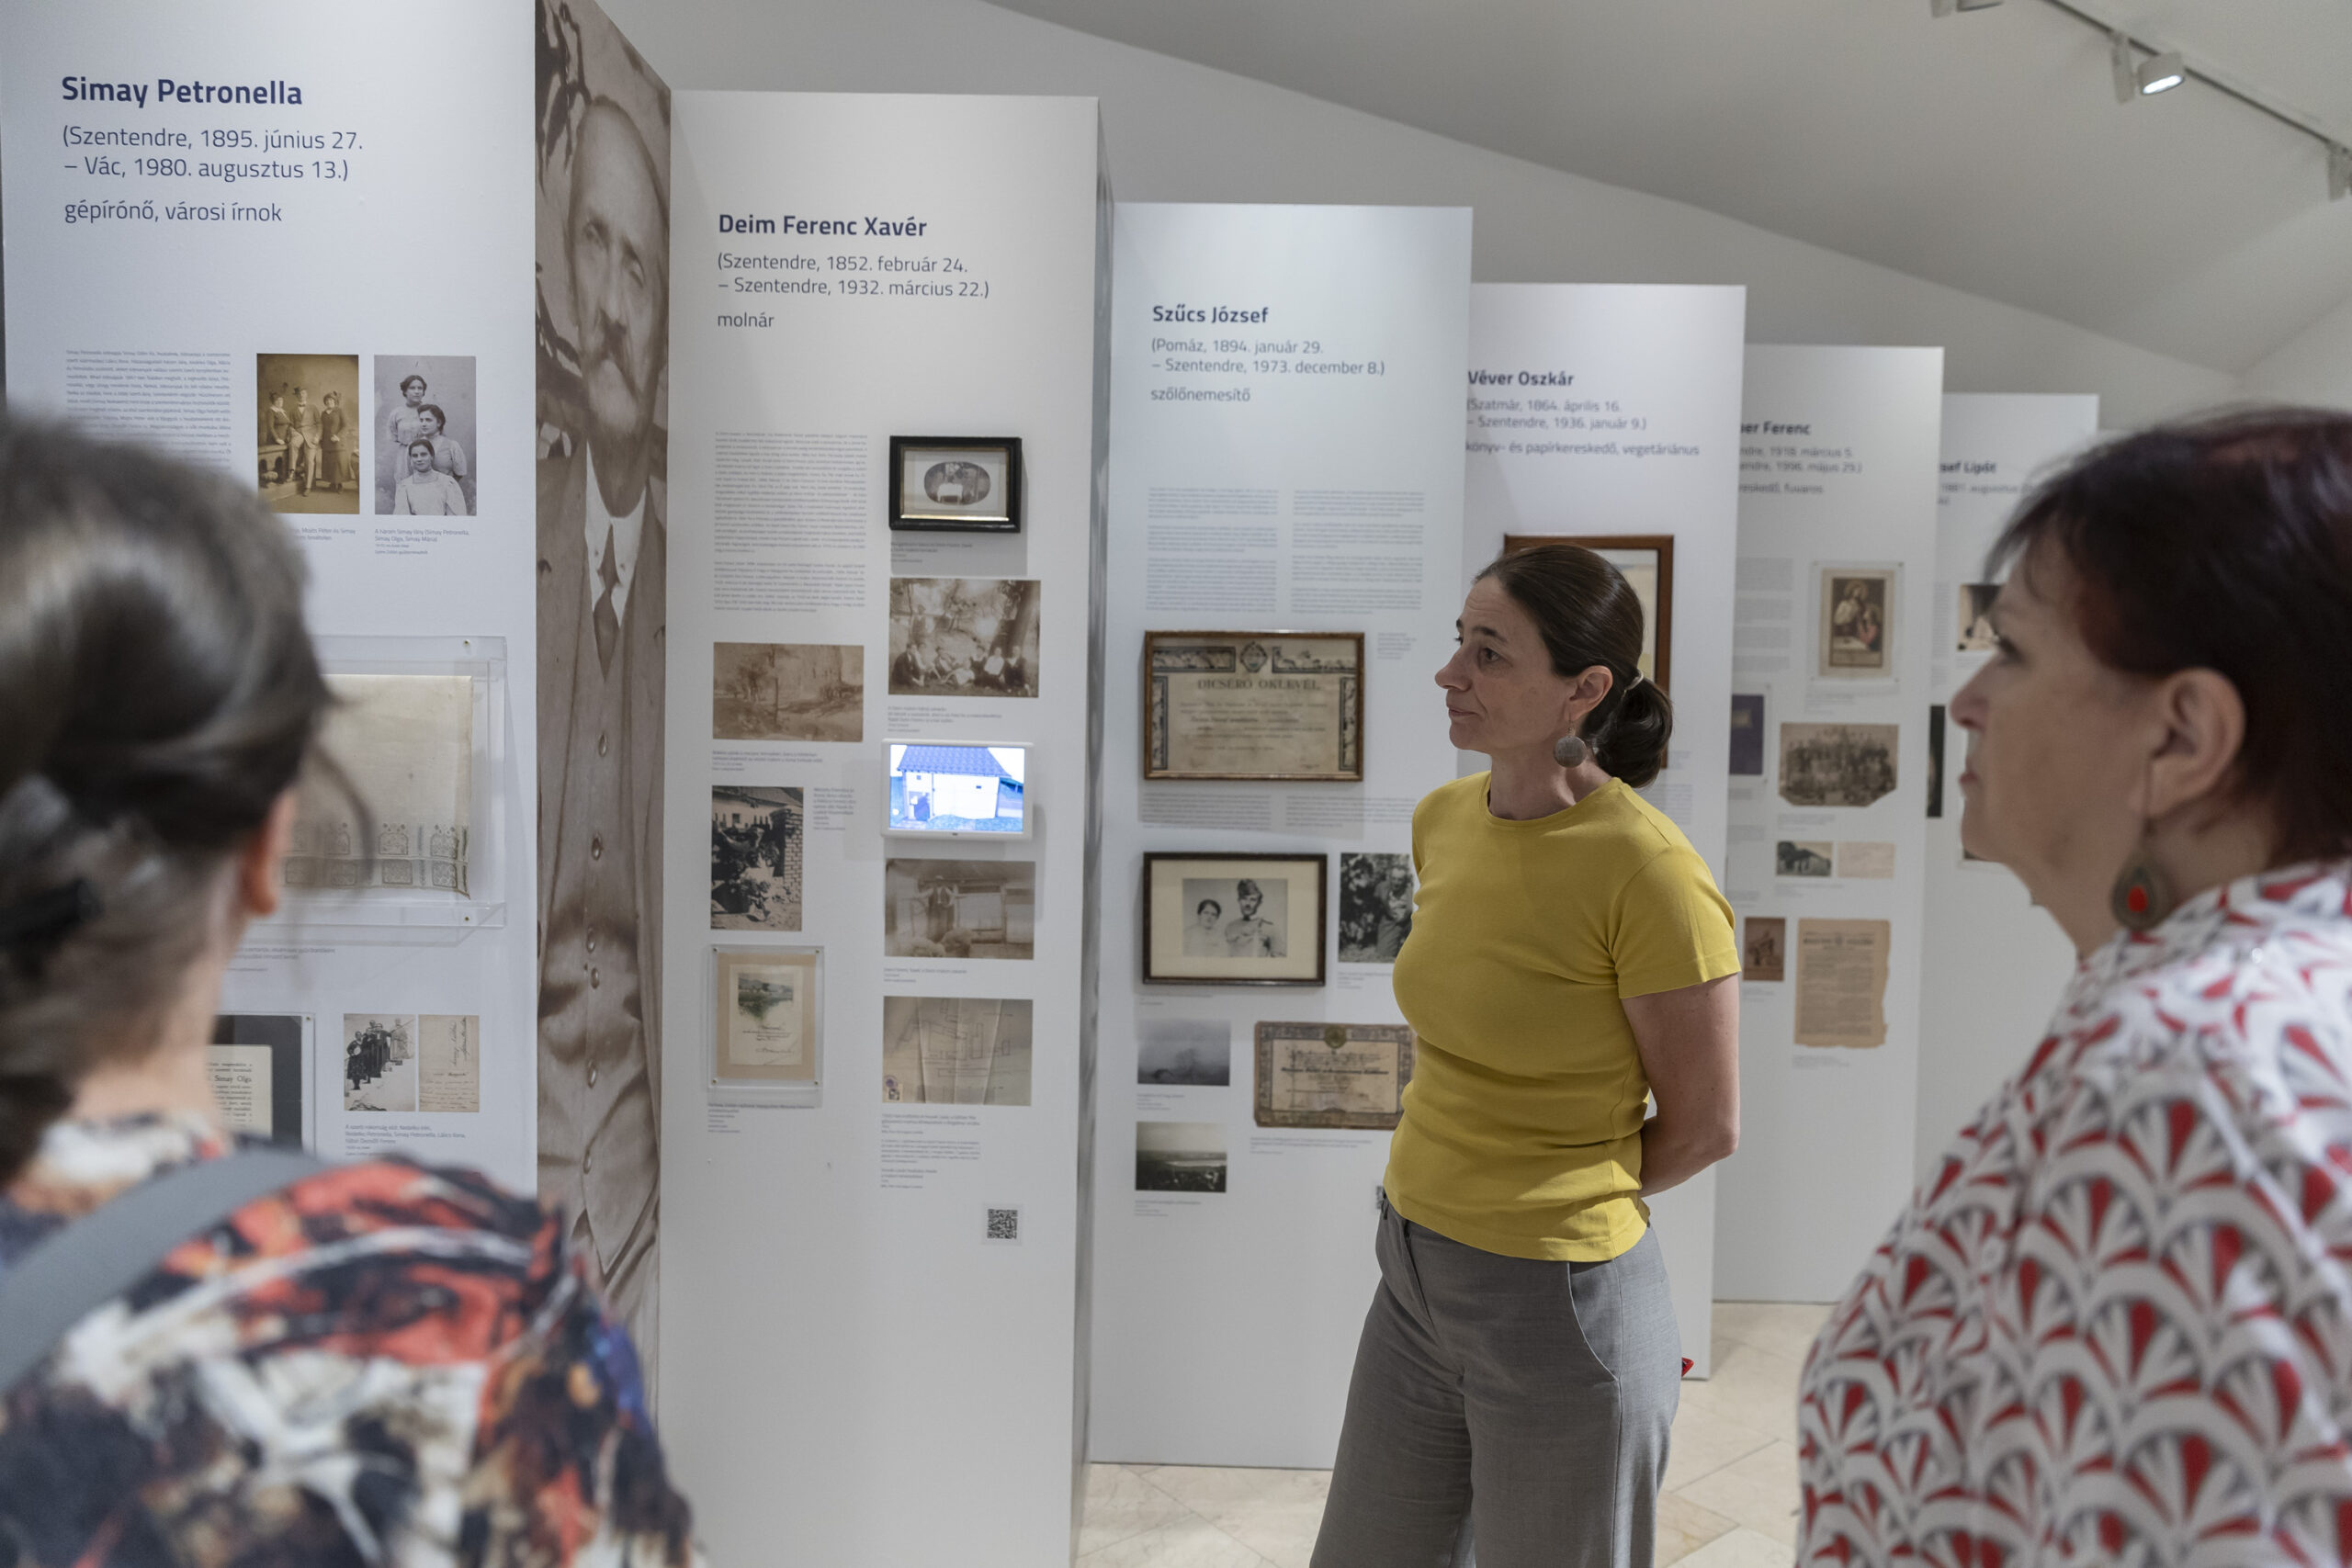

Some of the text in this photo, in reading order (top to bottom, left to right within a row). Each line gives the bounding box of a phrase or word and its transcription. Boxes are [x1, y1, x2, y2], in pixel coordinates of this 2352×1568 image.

[62, 76, 302, 108] Simay Petronella
[63, 125, 362, 152] (Szentendre, 1895. június 27.
[85, 156, 125, 177] Vác,
[135, 159, 191, 176] 1980.
[198, 161, 303, 182] augusztus
[312, 160, 347, 181] 13.)
[65, 199, 281, 223] gépírónő, városi írnok
[719, 215, 927, 236] Deim Ferenc Xavér
[718, 253, 967, 272] (Szentendre, 1852. február 24.
[735, 277, 831, 296] Szentendre,
[839, 280, 883, 294] 1932.
[889, 280, 953, 296] március
[959, 281, 989, 299] 22.)
[718, 312, 775, 327] molnár
[1153, 304, 1268, 323] Szűcs József
[1152, 338, 1323, 355] (Pomáz, 1894. január 29.
[1166, 358, 1247, 374] Szentendre,
[1253, 360, 1291, 374] 1973.
[1295, 361, 1363, 374] december
[1367, 361, 1385, 376] 8.)
[1468, 370, 1574, 386] Véver Oszkár
[1151, 387, 1250, 401] szőlőnemesítő
[1564, 400, 1600, 413] április
[1477, 416, 1549, 429] Szentendre,
[1590, 418, 1627, 430] január
[1763, 421, 1811, 435] Ferenc
[1509, 443, 1522, 453] és
